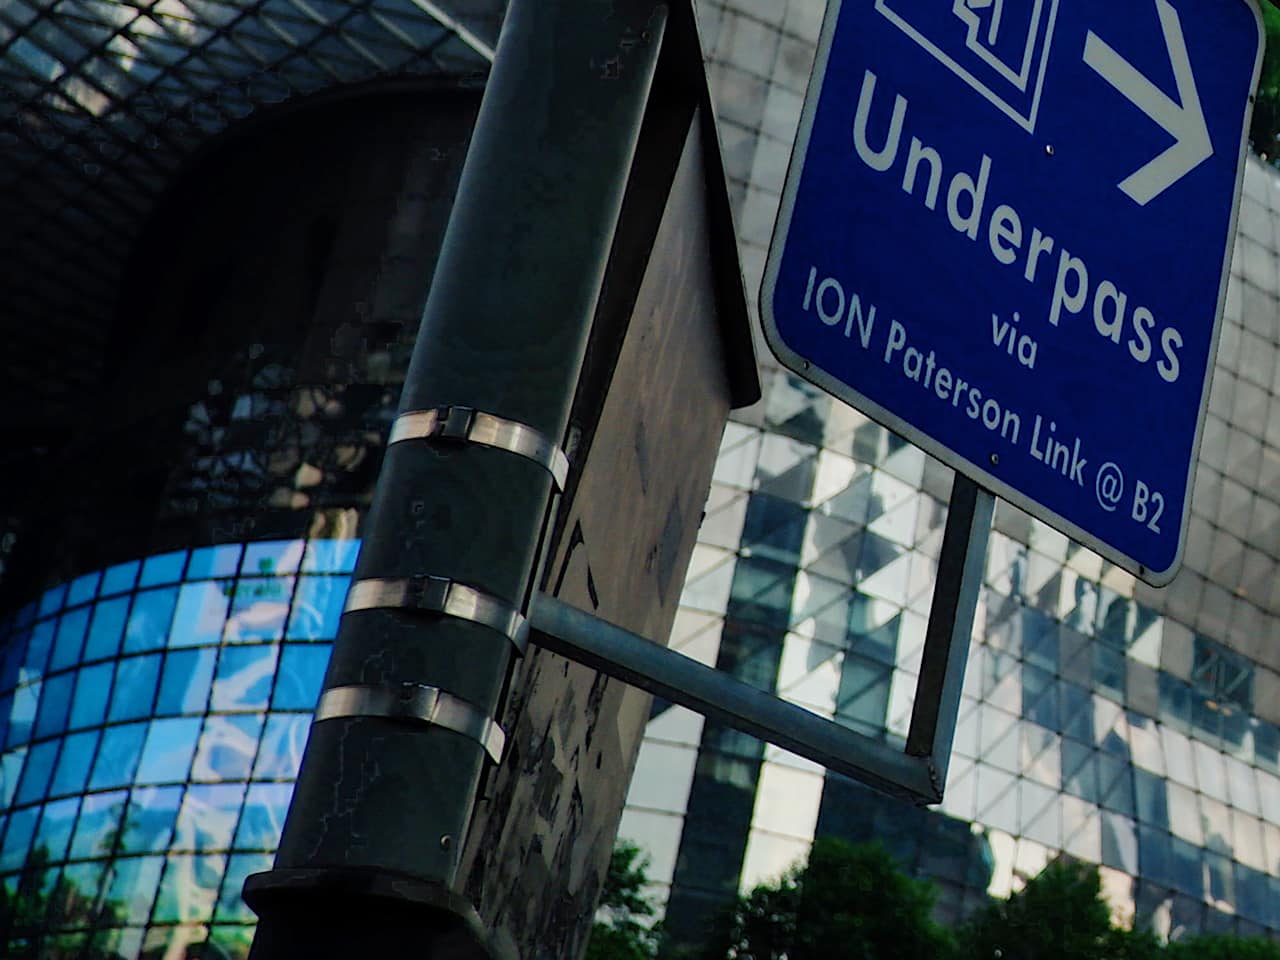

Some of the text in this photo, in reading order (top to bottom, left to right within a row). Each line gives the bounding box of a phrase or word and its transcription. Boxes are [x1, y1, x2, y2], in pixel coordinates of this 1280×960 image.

[853, 69, 1184, 383] Underpass
[991, 311, 1038, 369] via
[802, 266, 1165, 534] ION Paterson Link @ B2
